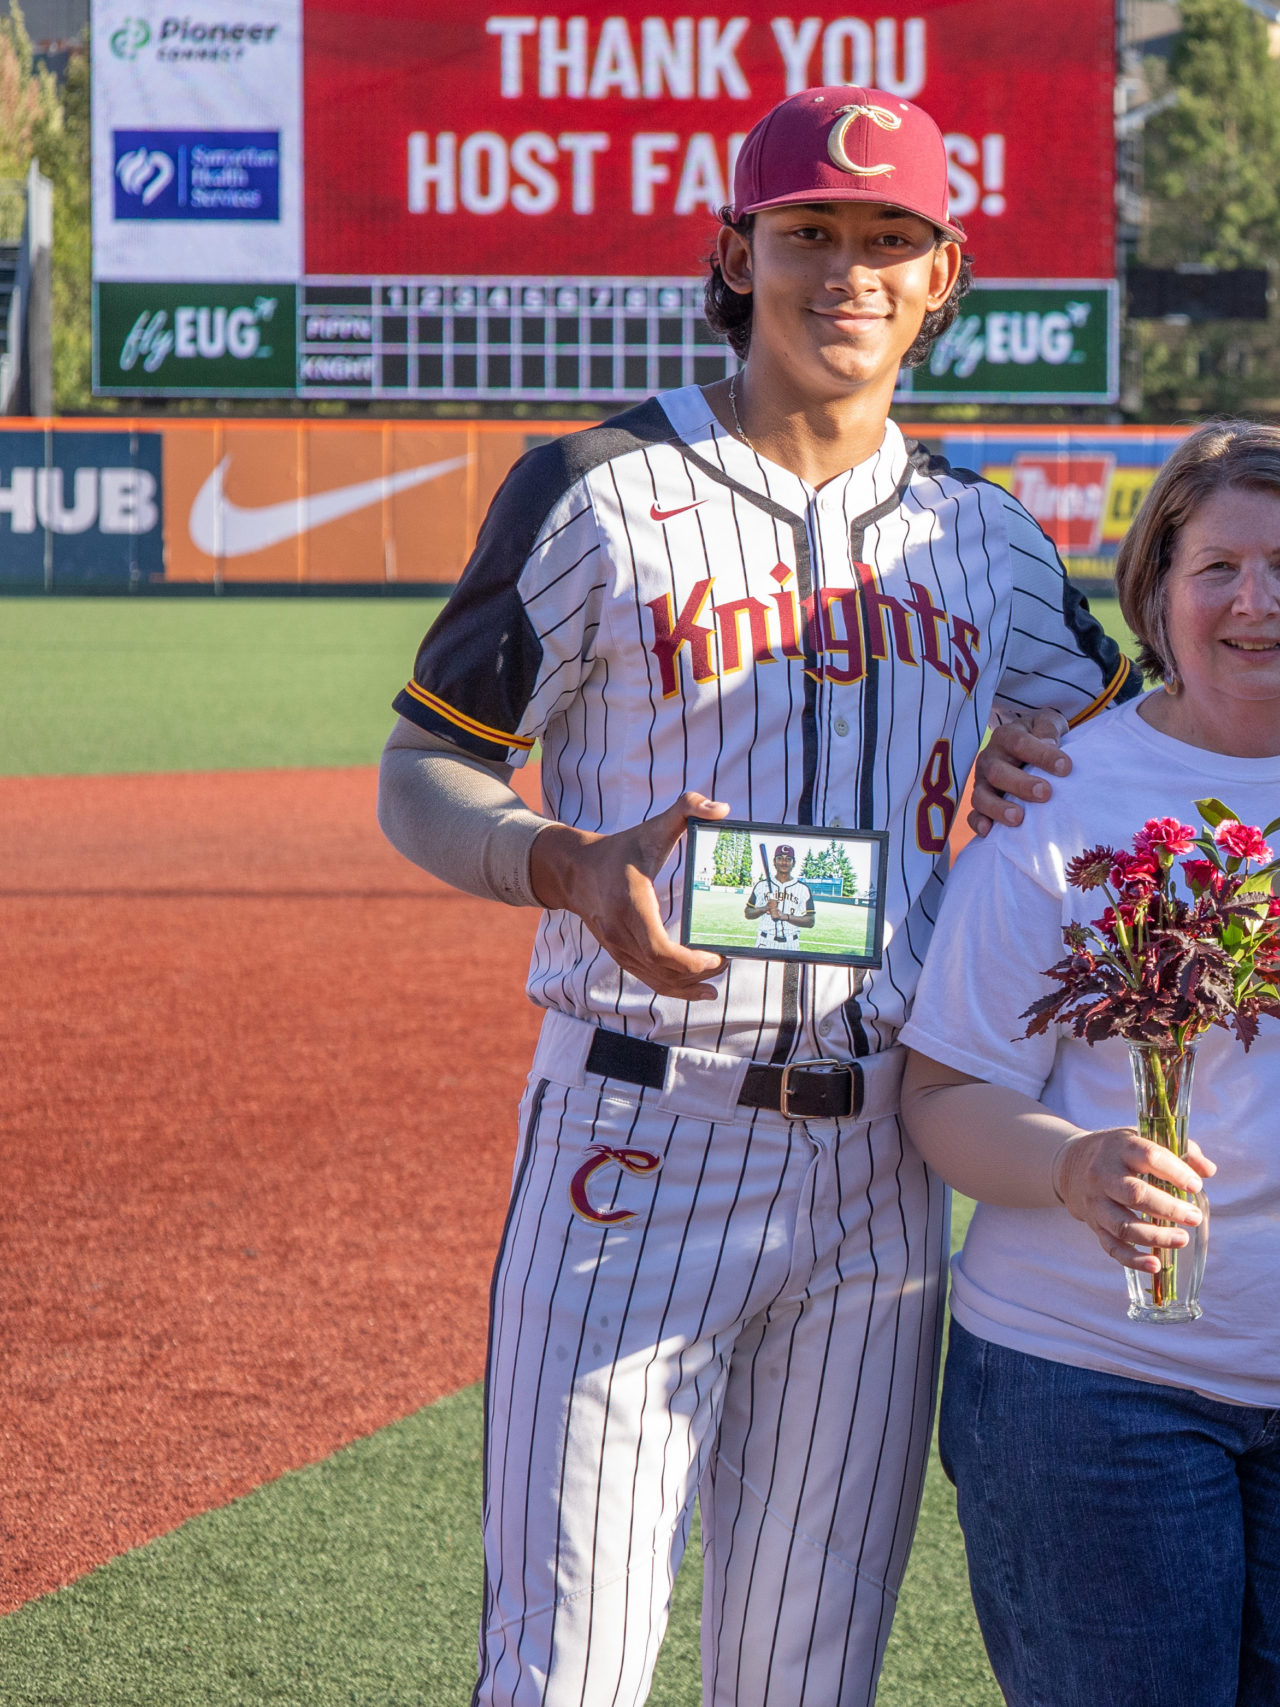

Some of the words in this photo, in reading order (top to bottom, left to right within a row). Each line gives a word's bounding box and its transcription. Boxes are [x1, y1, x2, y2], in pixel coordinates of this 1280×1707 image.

[159, 17, 279, 42] Pioneer
[486, 16, 750, 99] THANK
[771, 16, 926, 99] YOU
[408, 131, 610, 215] HOST
[388, 286, 404, 309] 1
[175, 306, 260, 359] EUG
[985, 311, 1074, 364] EUG
[645, 561, 980, 700] Knights
[916, 738, 956, 855] 8
[763, 890, 799, 905] Kights
